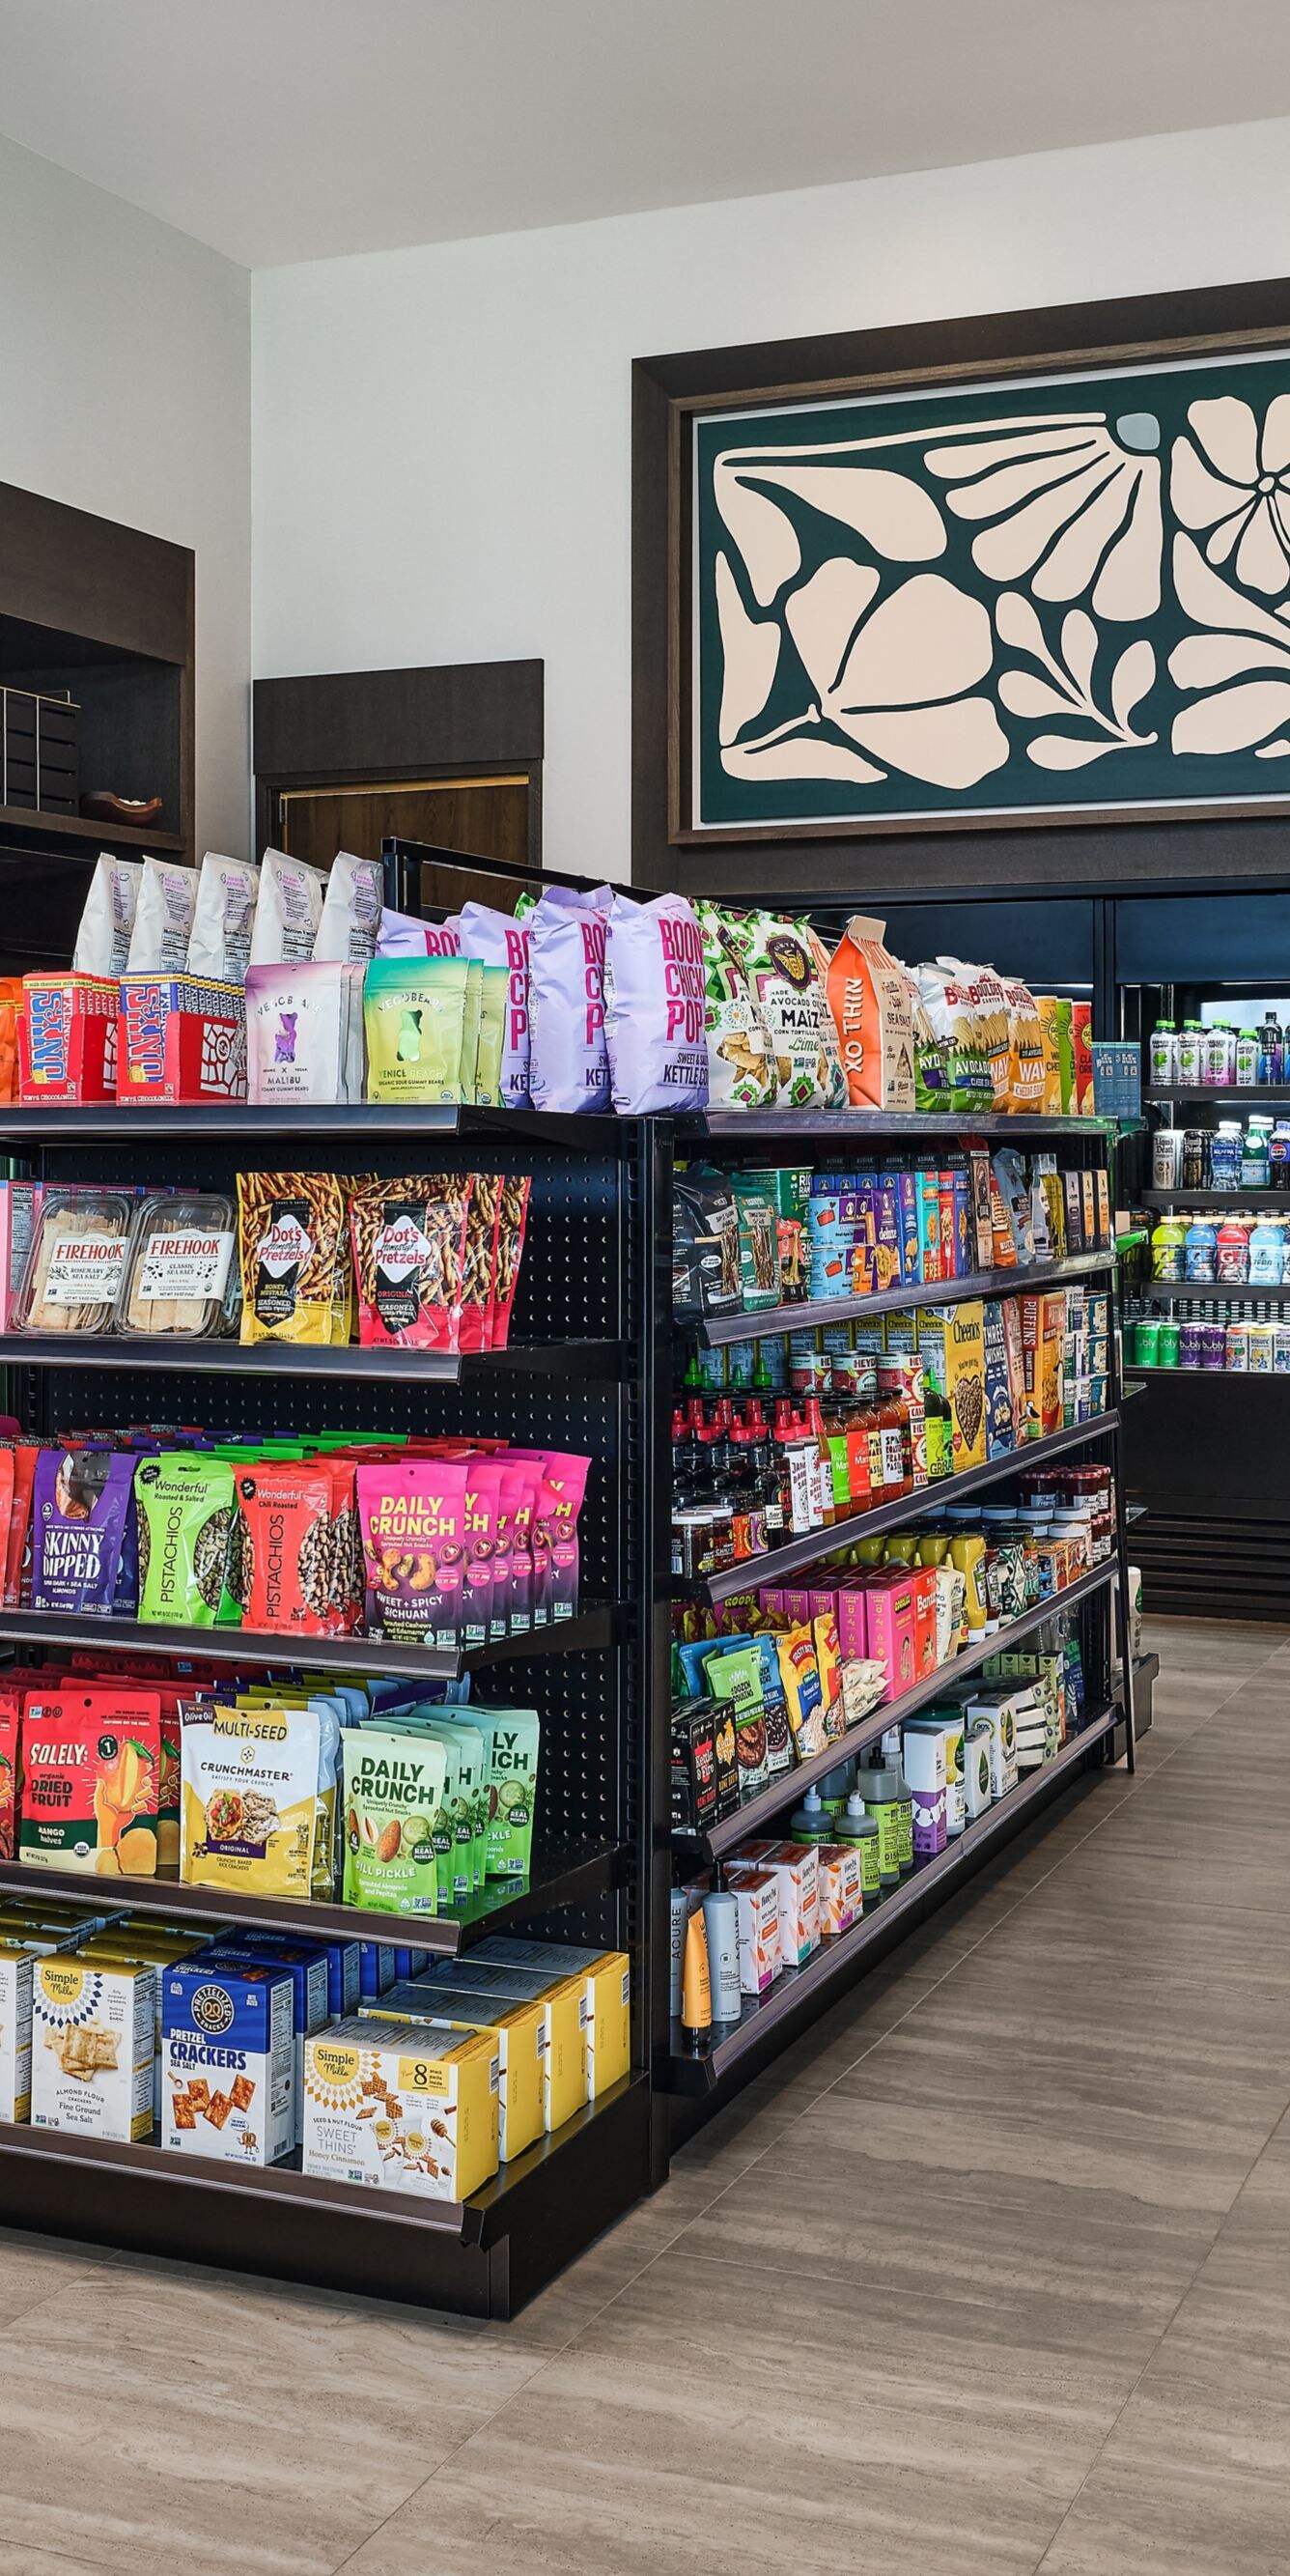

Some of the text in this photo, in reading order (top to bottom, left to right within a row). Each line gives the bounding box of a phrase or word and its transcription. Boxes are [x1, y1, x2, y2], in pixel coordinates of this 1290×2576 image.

[664, 963, 706, 1001] CHICK
[771, 997, 810, 1006] AVOCADO
[666, 1001, 703, 1044] POP
[842, 977, 864, 1073] XO THIN
[886, 1013, 899, 1026] SEA
[789, 1036, 820, 1052] Lime
[677, 1052, 695, 1063] SWEET
[663, 1064, 699, 1085] KETTLE
[1019, 1062, 1046, 1082] WAV
[1185, 1145, 1202, 1154] Death
[271, 1225, 302, 1243] Dot's
[382, 1226, 419, 1243] Dot's
[56, 1244, 125, 1260] FIREHOOK
[151, 1239, 221, 1255] FIREHOOK
[258, 1247, 305, 1261] Pretzels
[375, 1249, 426, 1264] Pretzels
[1024, 1300, 1037, 1345] PUFFINS
[953, 1318, 981, 1345] Cheerios
[983, 1323, 1004, 1345] THREE
[154, 1481, 208, 1494] Wonderful
[258, 1490, 301, 1500] Wonderful
[379, 1496, 444, 1515] DAILY
[370, 1517, 456, 1537] CRUNCH
[44, 1531, 104, 1556] SKINNY
[160, 1506, 183, 1603] PISTACHIOS
[42, 1553, 101, 1579] DIPPED
[266, 1514, 285, 1618] PISTACHIOS
[377, 1591, 403, 1606] SWEET
[411, 1595, 443, 1608] SPICY
[724, 1595, 756, 1607] GOODL
[384, 1607, 429, 1619] SICHUAN
[735, 1681, 751, 1693] DOZEN
[184, 1712, 213, 1722] Olive Oil
[213, 1721, 288, 1741] MULTI-SEED
[104, 1741, 111, 1753] 1
[695, 1749, 714, 1769] Kettle
[201, 1762, 291, 1781] CRUNCHMASTER
[361, 1757, 425, 1783] DAILY
[701, 1763, 715, 1776] Fire
[31, 1780, 73, 1796] DRIED
[351, 1776, 434, 1805] CRUNCH
[32, 1795, 72, 1807] FRUIT
[367, 1798, 407, 1810] Uniquely Crunchy
[38, 1826, 65, 1836] MANGO
[40, 1835, 63, 1845] halves
[219, 1845, 250, 1854] ORIGINAL
[376, 1867, 417, 1879] PICKLE
[672, 1908, 682, 1960] ACURE
[44, 1970, 79, 1985] Simple
[176, 1965, 215, 1974] CRACKERS
[50, 1983, 73, 1996] Mills
[193, 1987, 232, 2017] PRETZELIZED
[200, 2020, 225, 2030] SNACKS
[170, 2028, 207, 2044] PRETZEL
[170, 2042, 247, 2071] CRACKERS
[318, 2050, 355, 2065] Simple
[182, 2061, 195, 2070] SALT
[323, 2063, 350, 2077] Mills
[413, 2064, 428, 2084] 8
[84, 2091, 105, 2103] FLOUR
[59, 2102, 101, 2115] Fine Ground
[66, 2112, 93, 2123] Sea Salt
[317, 2126, 357, 2142] SWEET
[345, 2121, 363, 2132] FLOUR
[319, 2138, 354, 2155] THINS
[309, 2150, 365, 2166] Honey Cinnamon
